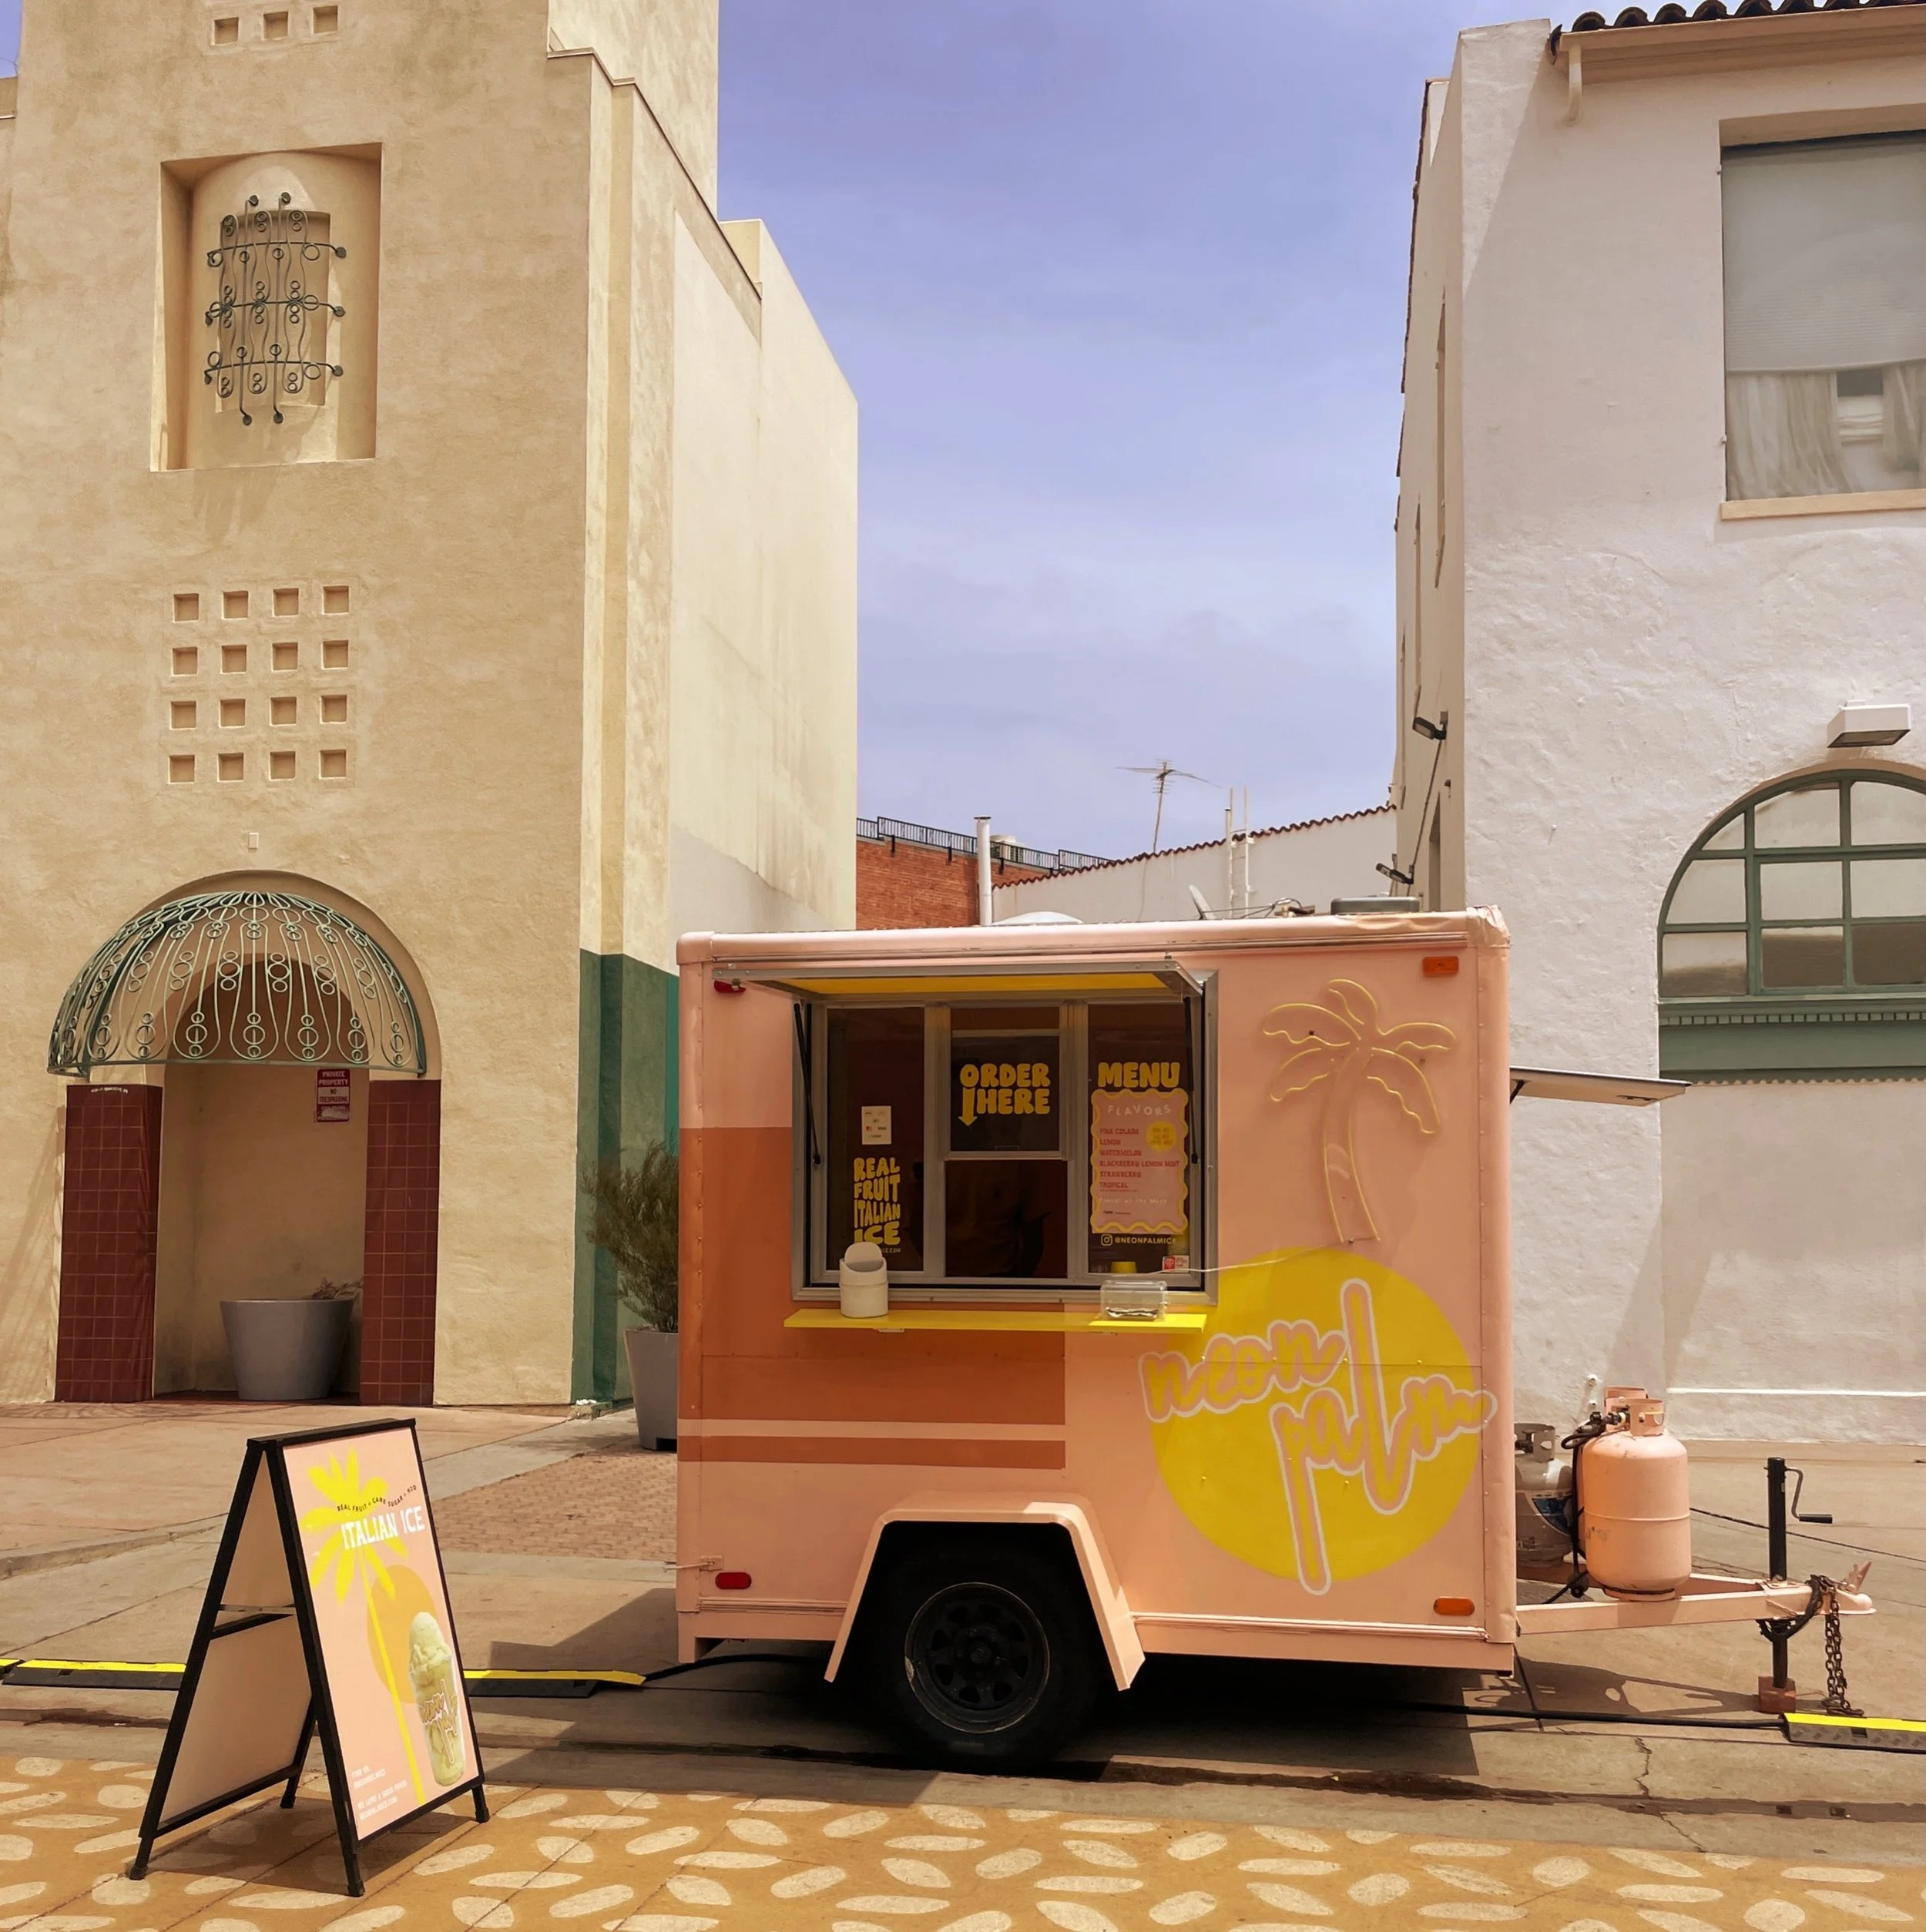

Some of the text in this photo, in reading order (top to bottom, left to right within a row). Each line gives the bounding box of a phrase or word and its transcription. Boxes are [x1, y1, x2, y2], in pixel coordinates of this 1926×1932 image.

[959, 1063, 1051, 1088] ORDER
[1097, 1062, 1180, 1088] MENU
[976, 1088, 1050, 1115] HERE
[1107, 1104, 1171, 1116] FLAVORS
[854, 1157, 901, 1182] REAL
[854, 1174, 901, 1202] FRUIT
[854, 1199, 901, 1229] ITALIAN
[854, 1221, 901, 1246] ICE
[1138, 1320, 1348, 1423] neon
[1269, 1277, 1498, 1595] palm
[336, 1503, 351, 1511] REAL
[352, 1503, 367, 1512] FRUIT
[371, 1496, 386, 1505] CANE
[388, 1494, 403, 1508] SUGAR
[341, 1505, 425, 1550] ITALIAN ICE
